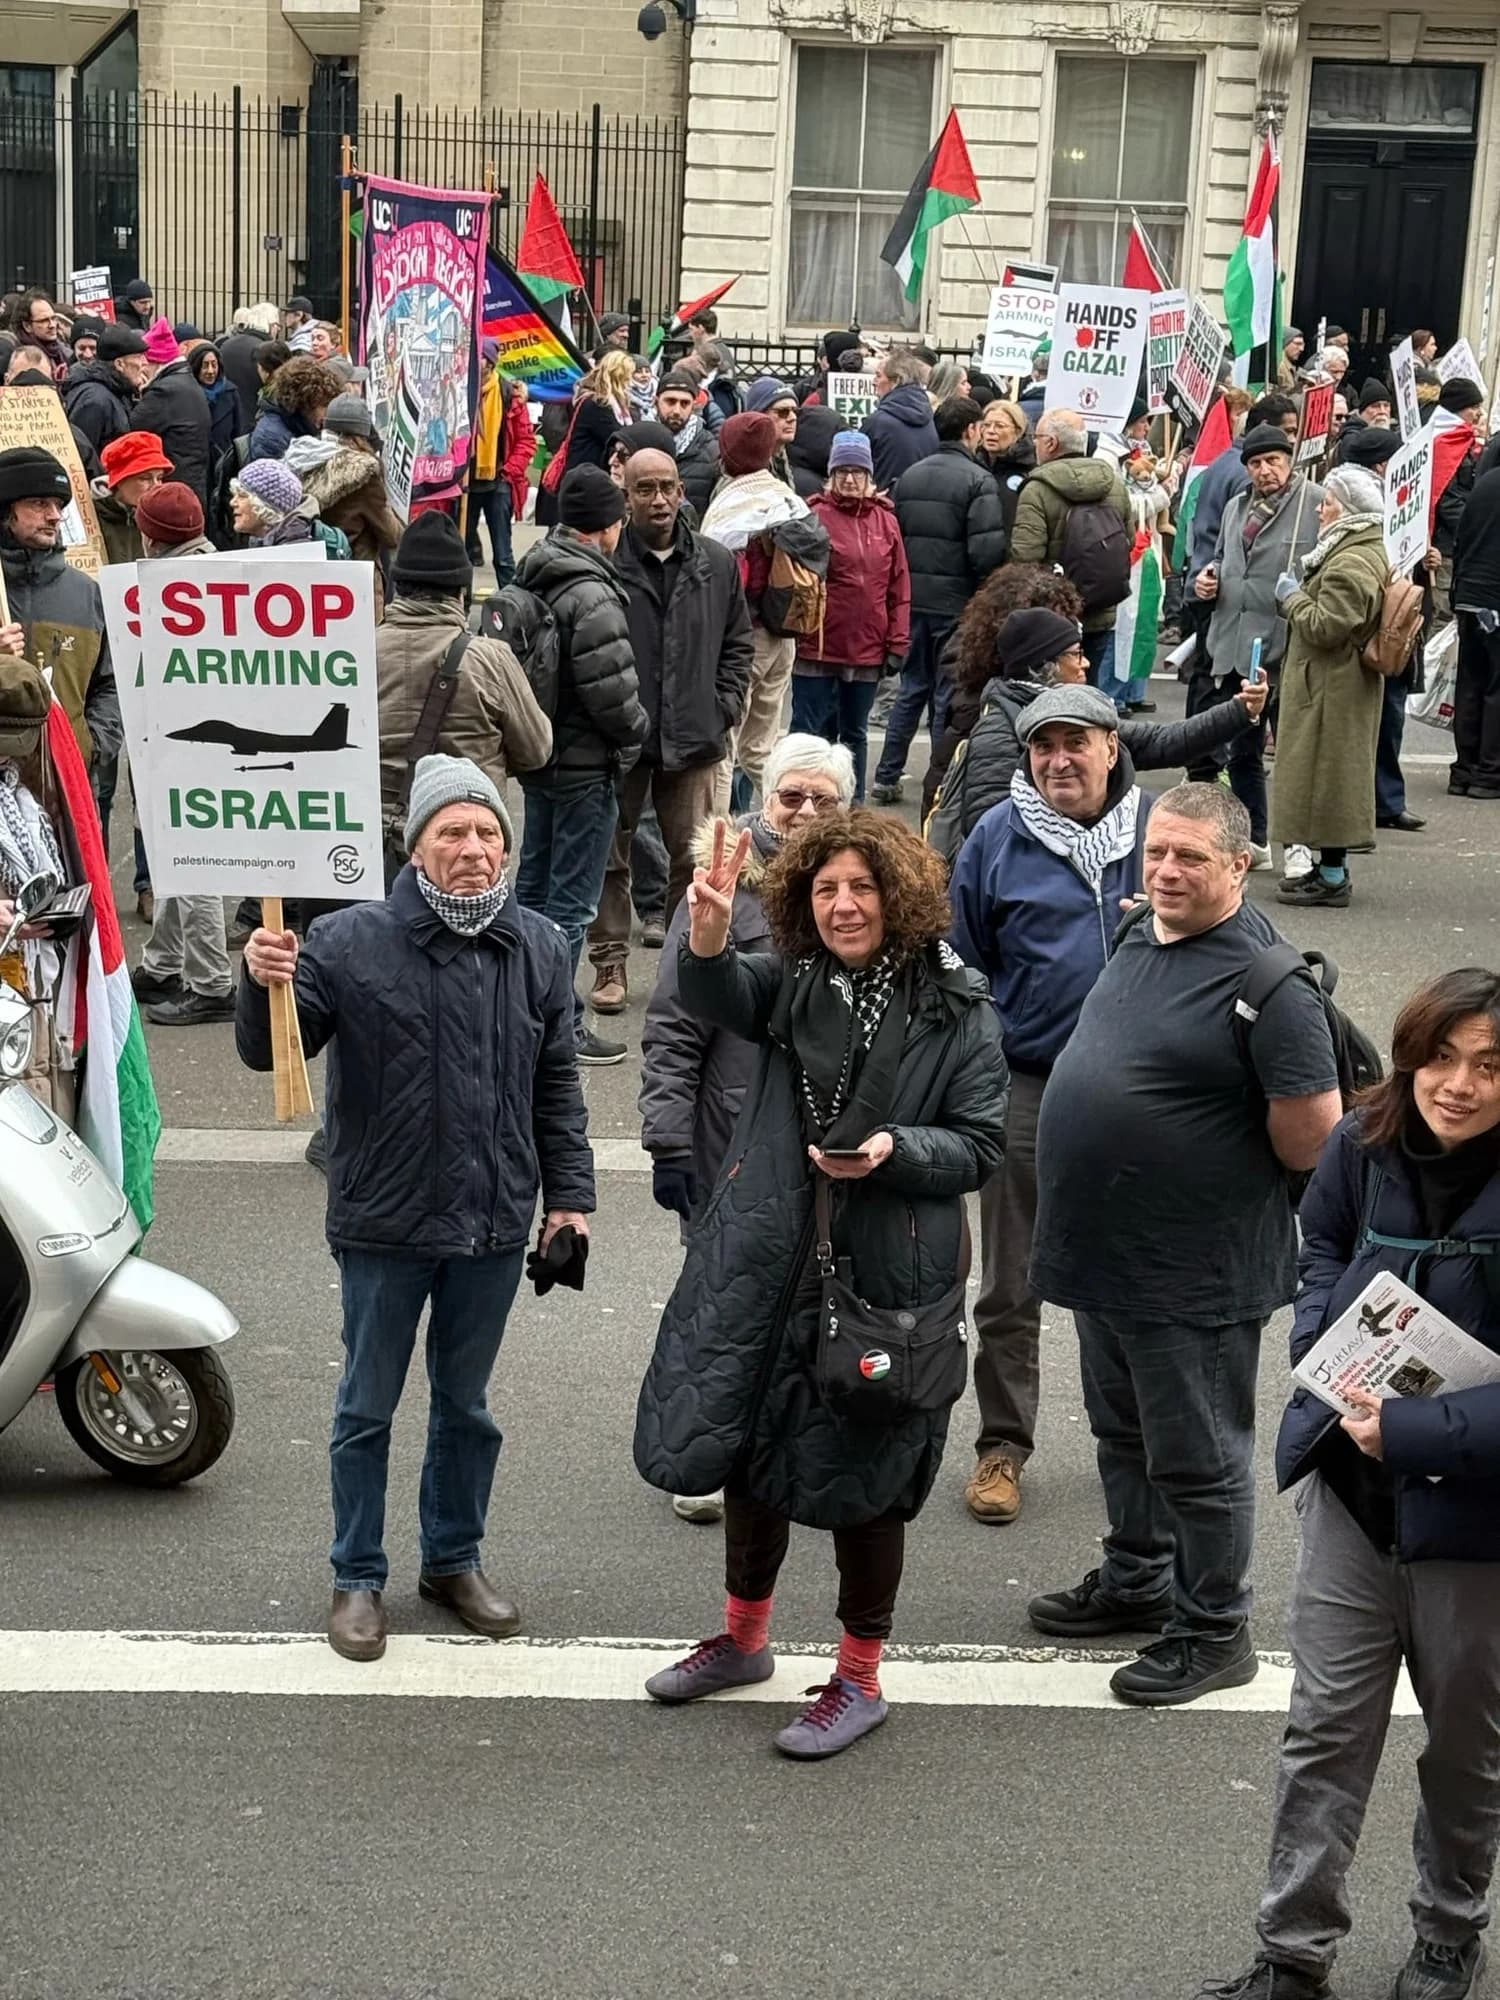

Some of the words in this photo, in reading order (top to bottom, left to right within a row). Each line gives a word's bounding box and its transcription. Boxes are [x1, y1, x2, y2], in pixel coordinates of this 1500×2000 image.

[373, 200, 399, 232] UCU
[456, 209, 480, 239] UCU
[998, 294, 1055, 312] STOP
[1065, 302, 1138, 329] HANDS
[1172, 310, 1185, 333] THE
[498, 333, 540, 355] grants
[990, 346, 1034, 360] ISRA
[1150, 336, 1172, 365] RIGHT
[1188, 320, 1218, 368] EXIST!
[503, 355, 540, 370] make
[540, 367, 568, 383] NHS
[1063, 350, 1127, 377] GAZA!
[834, 378, 855, 395] FREE
[835, 398, 877, 416] EXI
[393, 431, 412, 481] EE
[1390, 443, 1428, 493] HANDS
[1389, 489, 1424, 536] GAZA!
[161, 582, 355, 637] STOP
[163, 648, 358, 687] ARMING
[169, 788, 364, 832] ISRAEL
[173, 856, 295, 870] palestinecampaign.org
[334, 858, 357, 872] PSC
[1382, 1344, 1401, 1361] Back
[1338, 1360, 1359, 1381] Resist
[1370, 1363, 1396, 1388] Agenda
